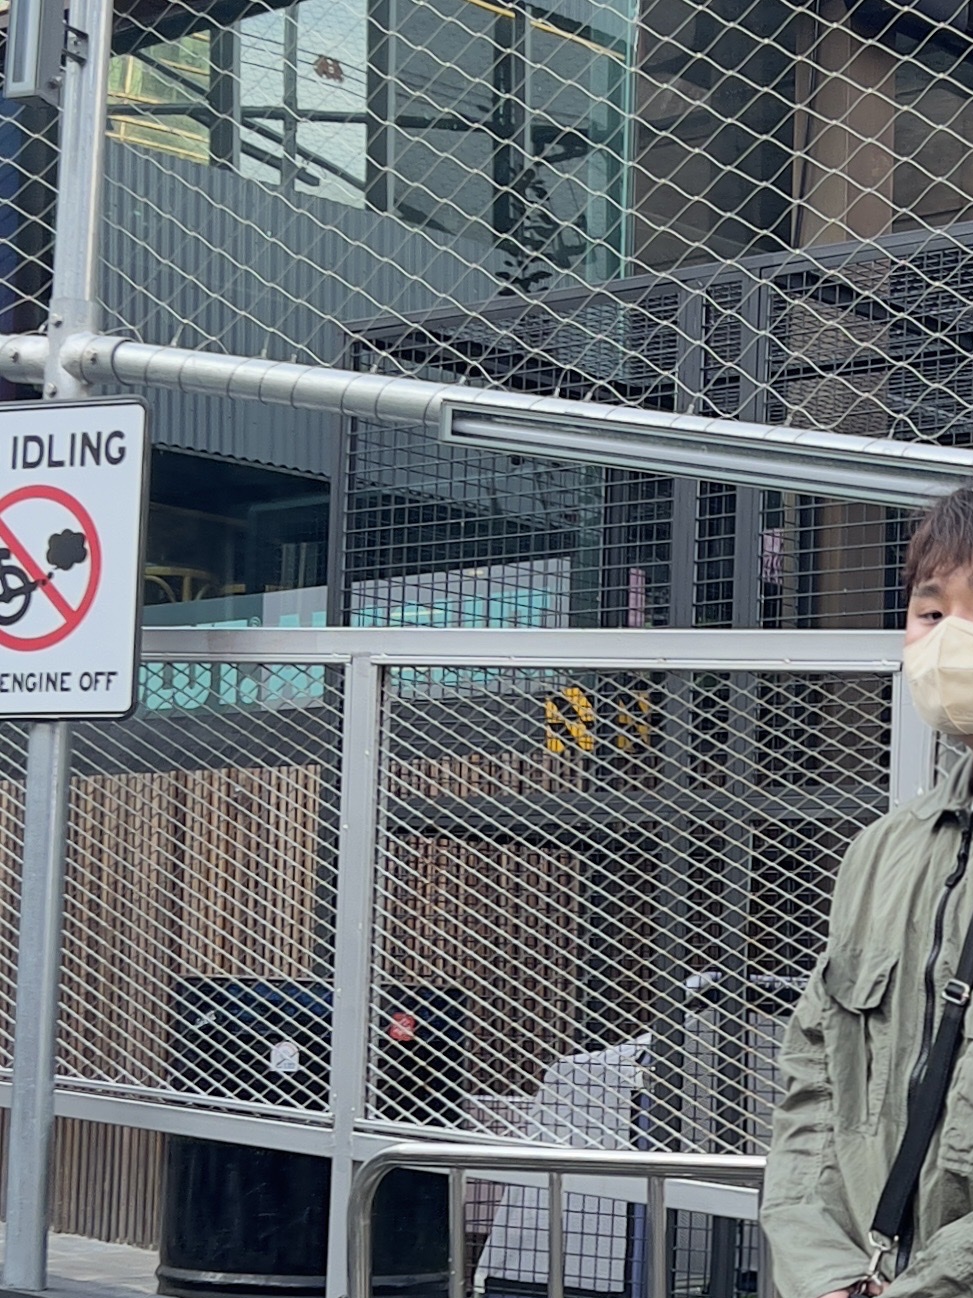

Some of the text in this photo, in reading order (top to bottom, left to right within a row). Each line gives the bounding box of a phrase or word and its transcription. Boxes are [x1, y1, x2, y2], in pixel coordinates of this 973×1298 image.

[11, 430, 126, 469] IDLING
[0, 672, 72, 693] ENGINE
[79, 672, 118, 692] OFF
